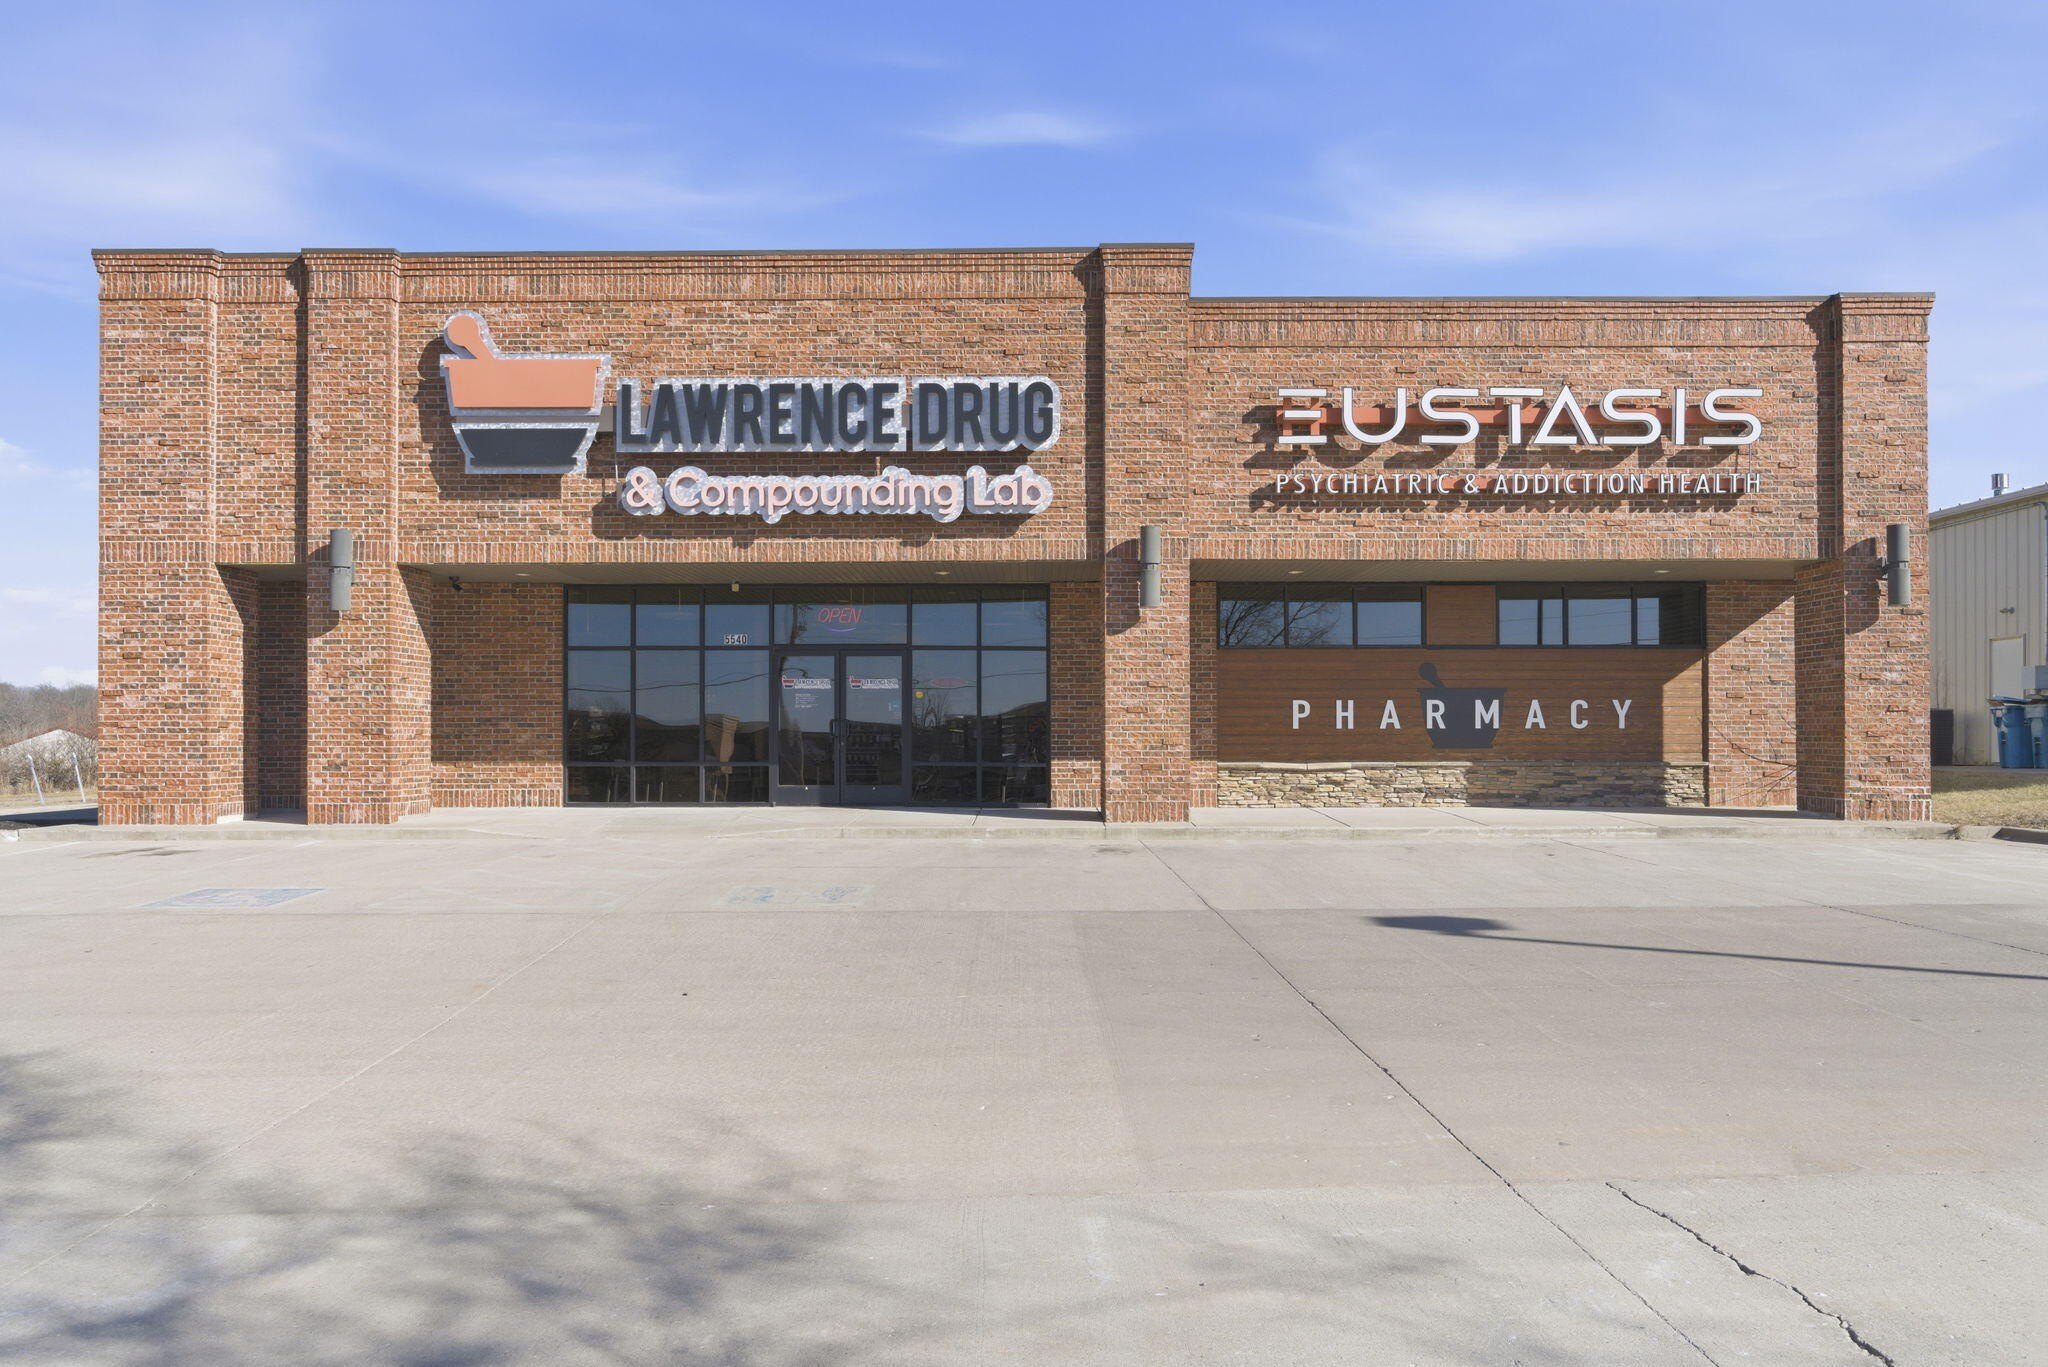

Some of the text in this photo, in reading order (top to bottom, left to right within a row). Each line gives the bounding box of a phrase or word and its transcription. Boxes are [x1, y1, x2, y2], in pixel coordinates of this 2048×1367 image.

[620, 382, 1054, 445] LAWRENCE DRUG
[1278, 384, 1764, 446] EUSTASIS
[626, 470, 1044, 516] & Compounding Lab
[1276, 473, 1761, 495] PSYCHIATRIC & ADDICTION HEALTH
[817, 607, 863, 625] OPEN
[724, 633, 748, 645] 5540
[1292, 699, 1633, 730] PHARMACY
